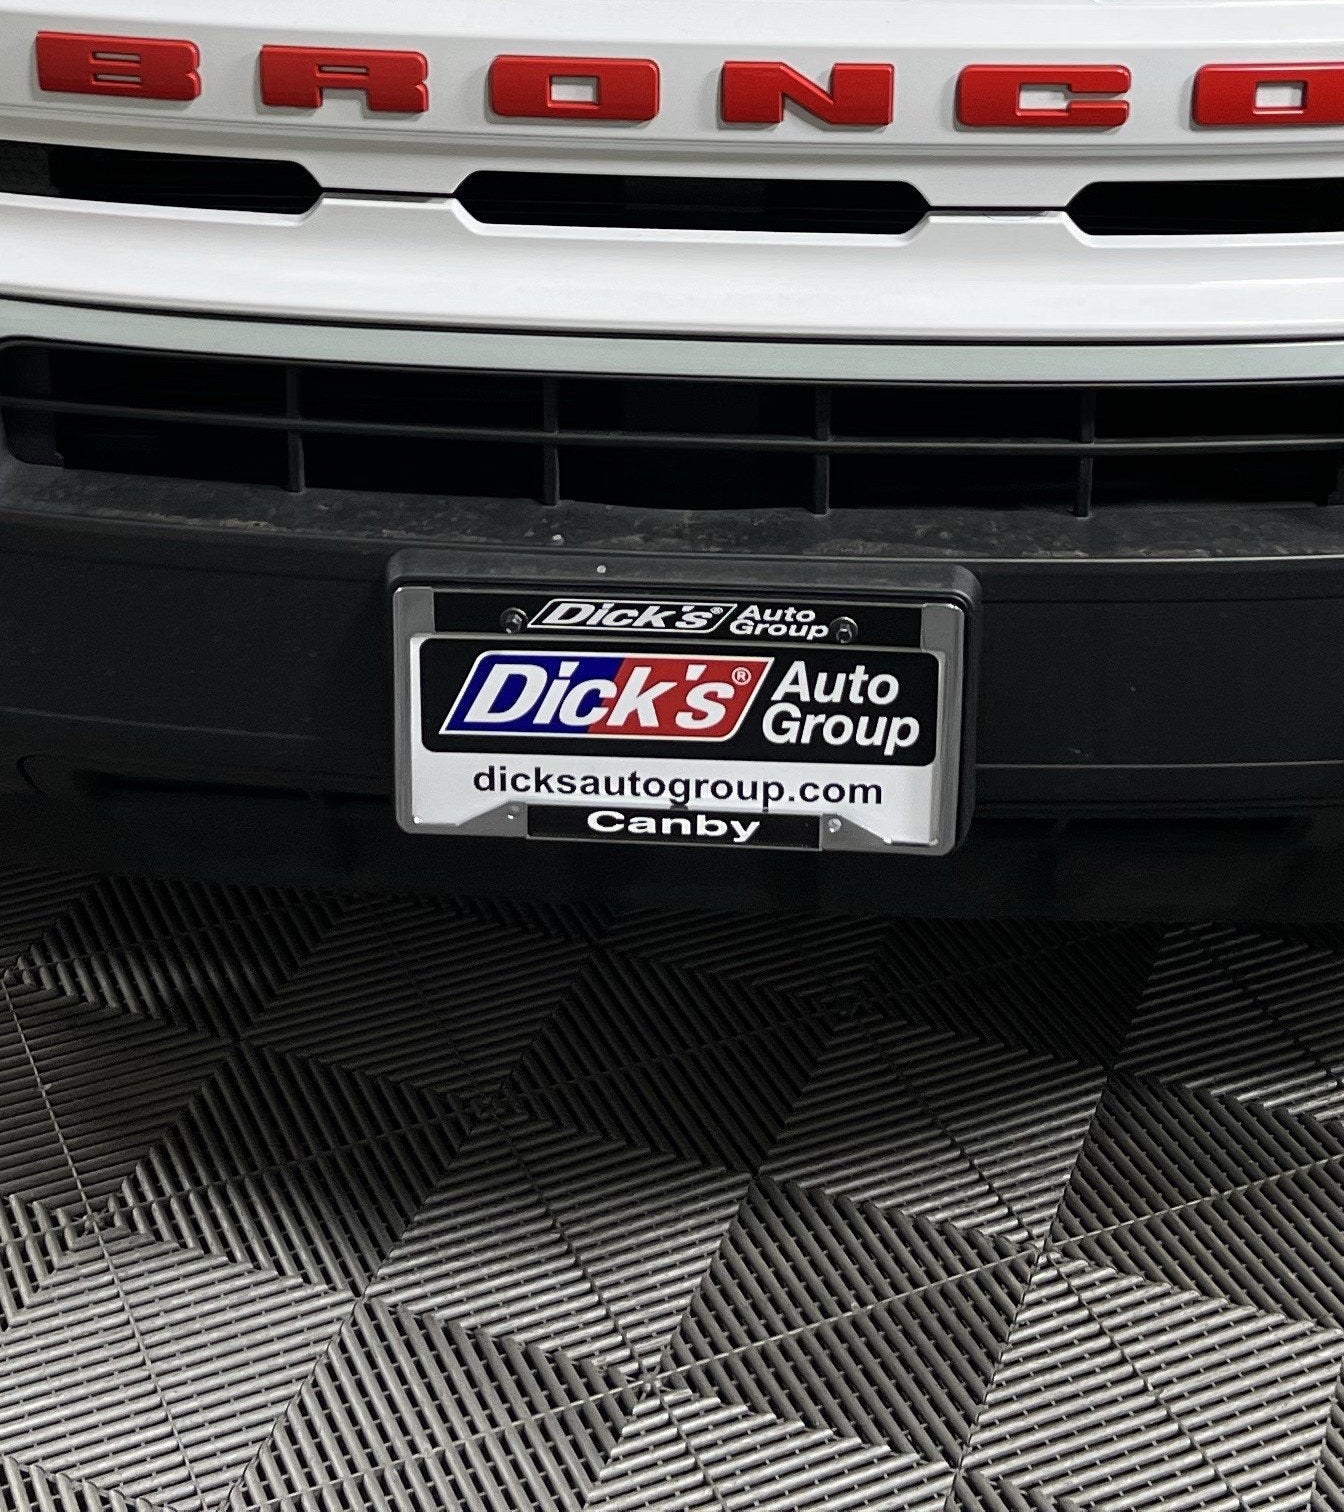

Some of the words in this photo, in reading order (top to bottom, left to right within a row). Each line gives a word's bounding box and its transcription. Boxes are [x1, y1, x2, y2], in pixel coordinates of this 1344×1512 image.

[542, 602, 714, 629] Dick's
[729, 619, 829, 641] Group
[737, 605, 816, 623] Auto
[463, 661, 736, 730] Dick's
[770, 660, 900, 706] Auto
[762, 702, 921, 757] Group
[473, 765, 883, 809] dicksautogroup.com
[587, 810, 760, 843] Canby
